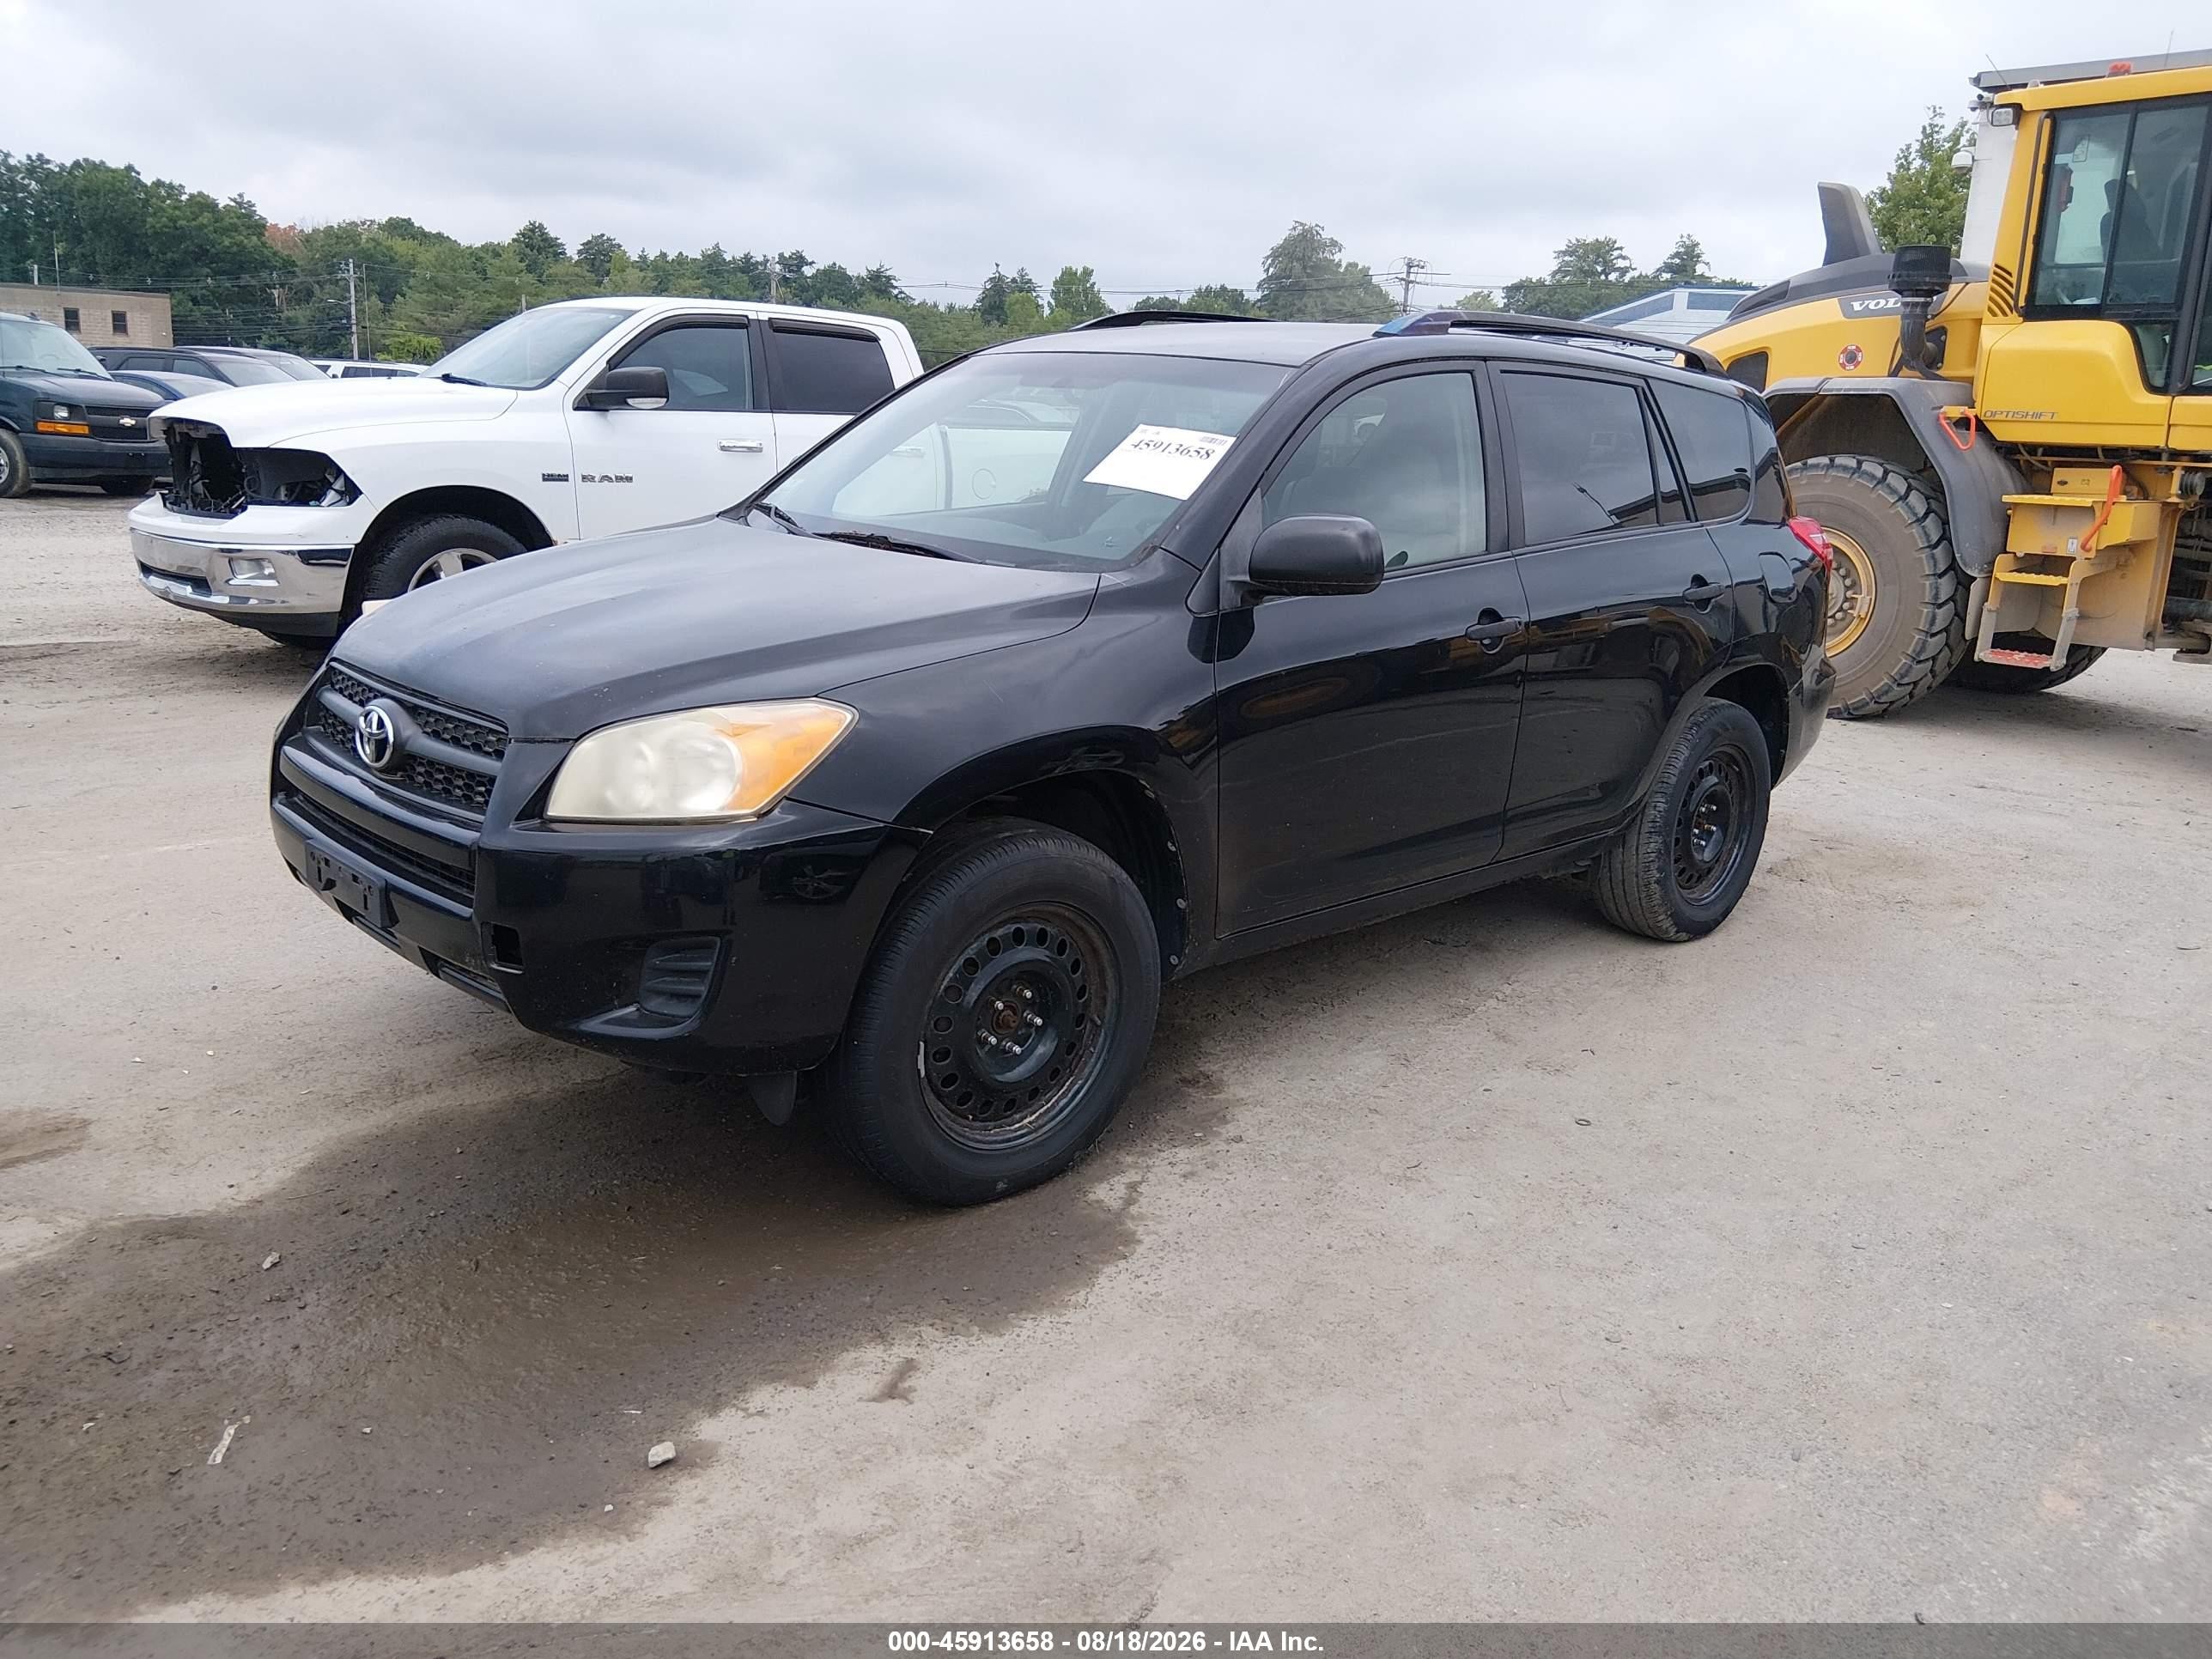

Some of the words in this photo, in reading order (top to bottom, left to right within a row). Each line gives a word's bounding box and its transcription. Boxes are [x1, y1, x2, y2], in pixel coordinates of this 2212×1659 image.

[1984, 410, 2058, 420] OPTISHIFT
[1131, 439, 1216, 460] 45913658
[581, 474, 634, 483] RAM
